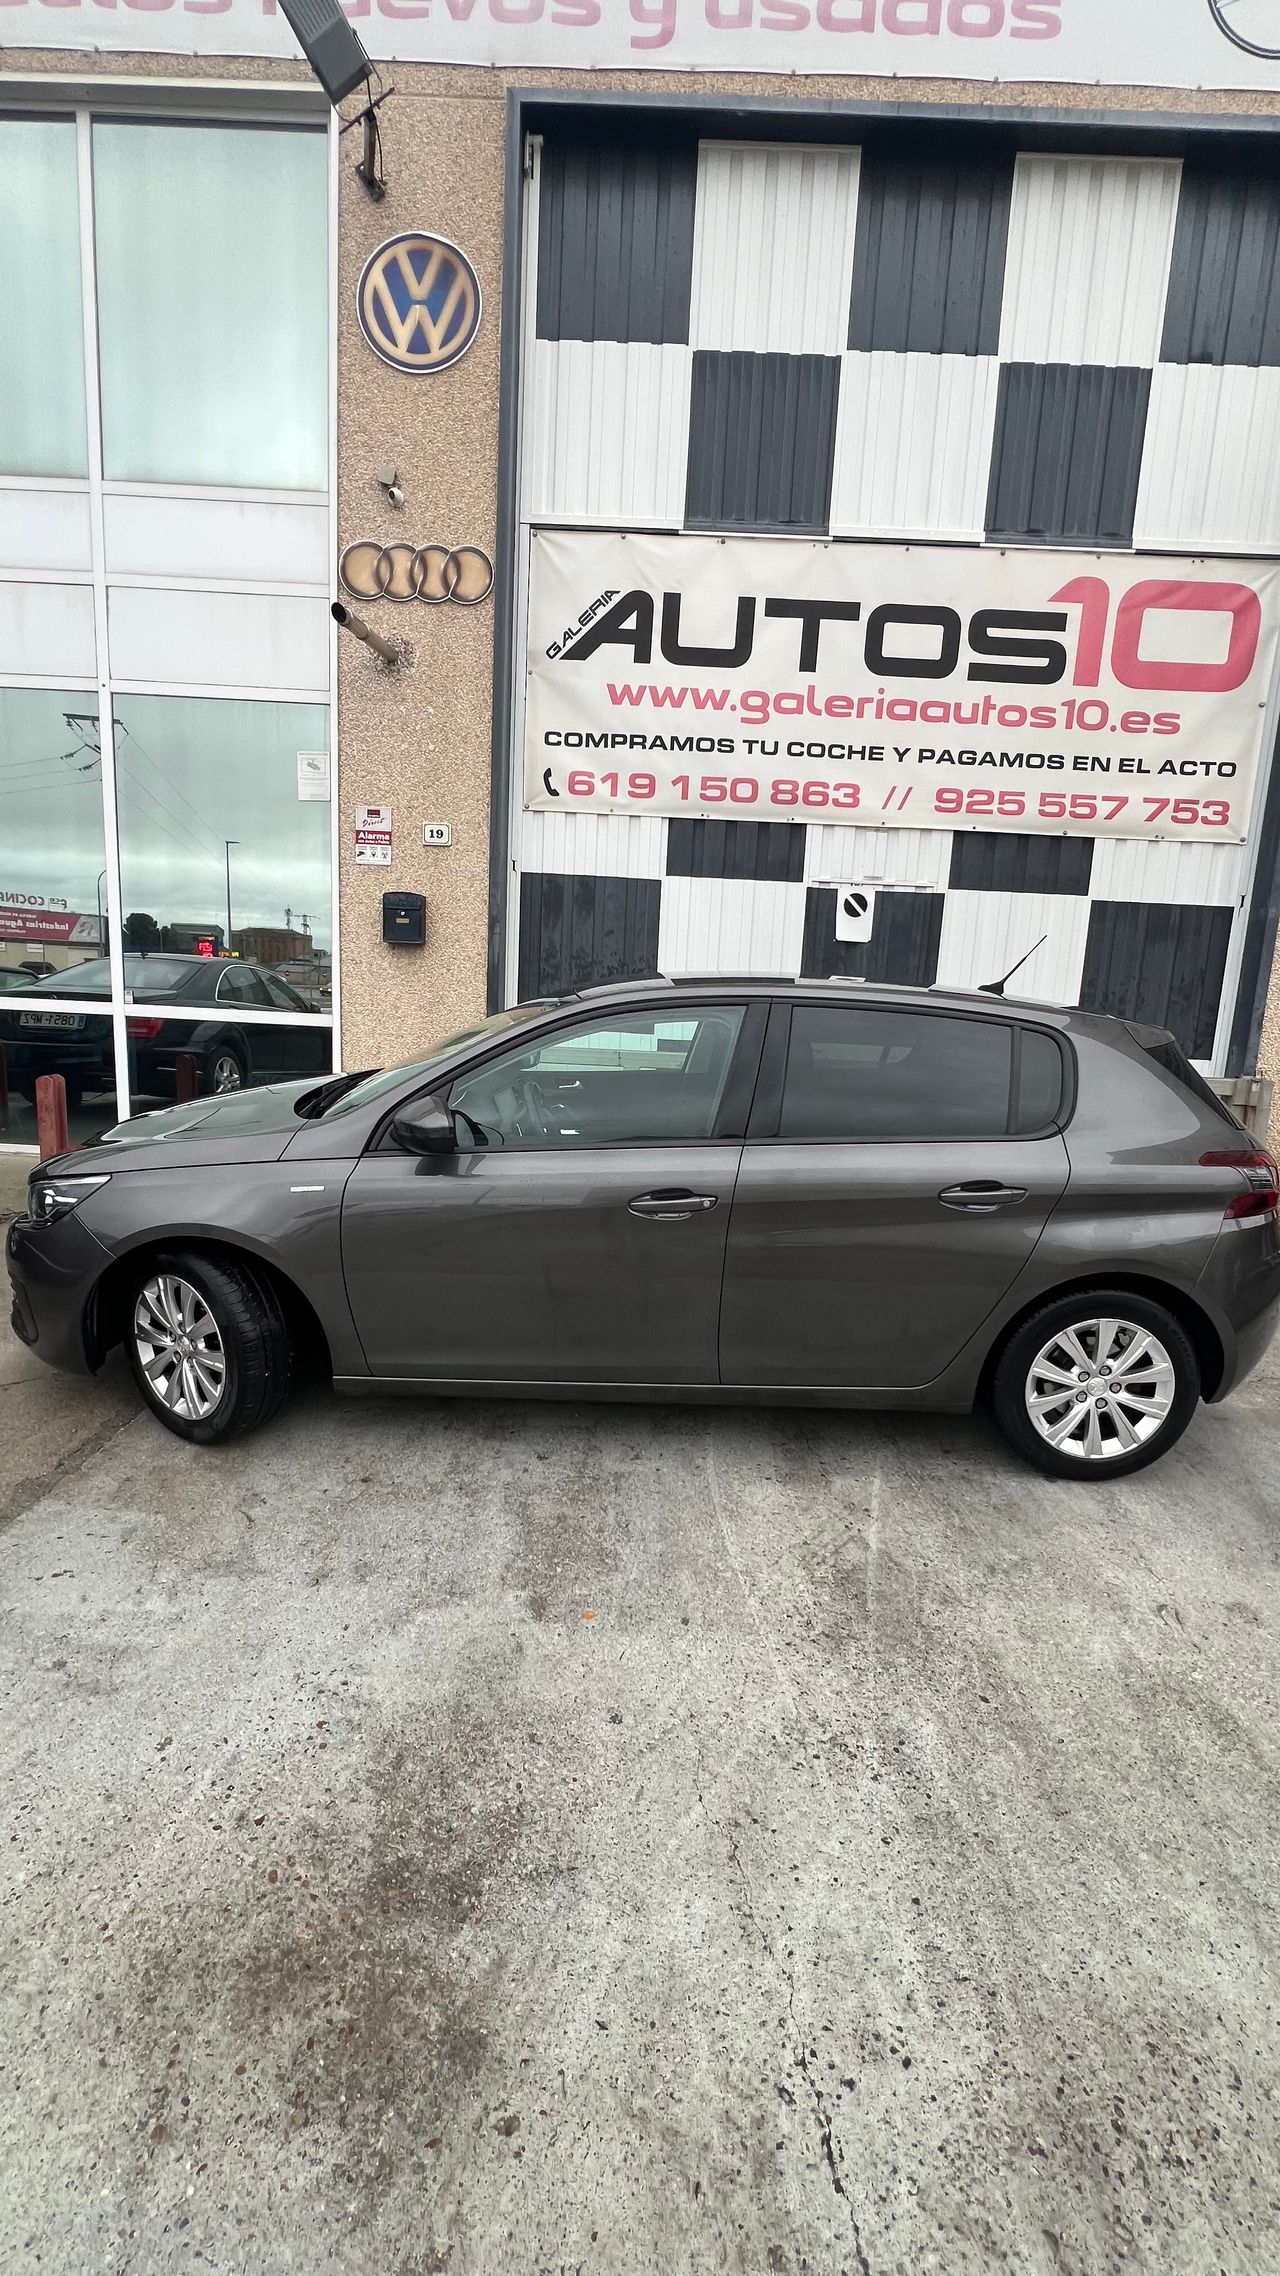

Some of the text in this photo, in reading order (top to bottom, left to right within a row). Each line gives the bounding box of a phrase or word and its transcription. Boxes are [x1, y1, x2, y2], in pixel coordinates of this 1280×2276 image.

[542, 589, 621, 660] GALERIA
[608, 684, 1181, 736] www.galeriaautos10.es
[543, 731, 1237, 778] COMPRAMOS TU COCHE Y PAGAMOS EN EL ACTO
[567, 769, 657, 800] 619
[671, 774, 760, 804] 150
[769, 778, 861, 810] 863
[933, 787, 1026, 817] 925
[1037, 791, 1130, 822] 557
[1142, 796, 1232, 827] 753
[358, 831, 390, 841] Alarma
[429, 829, 444, 839] 19
